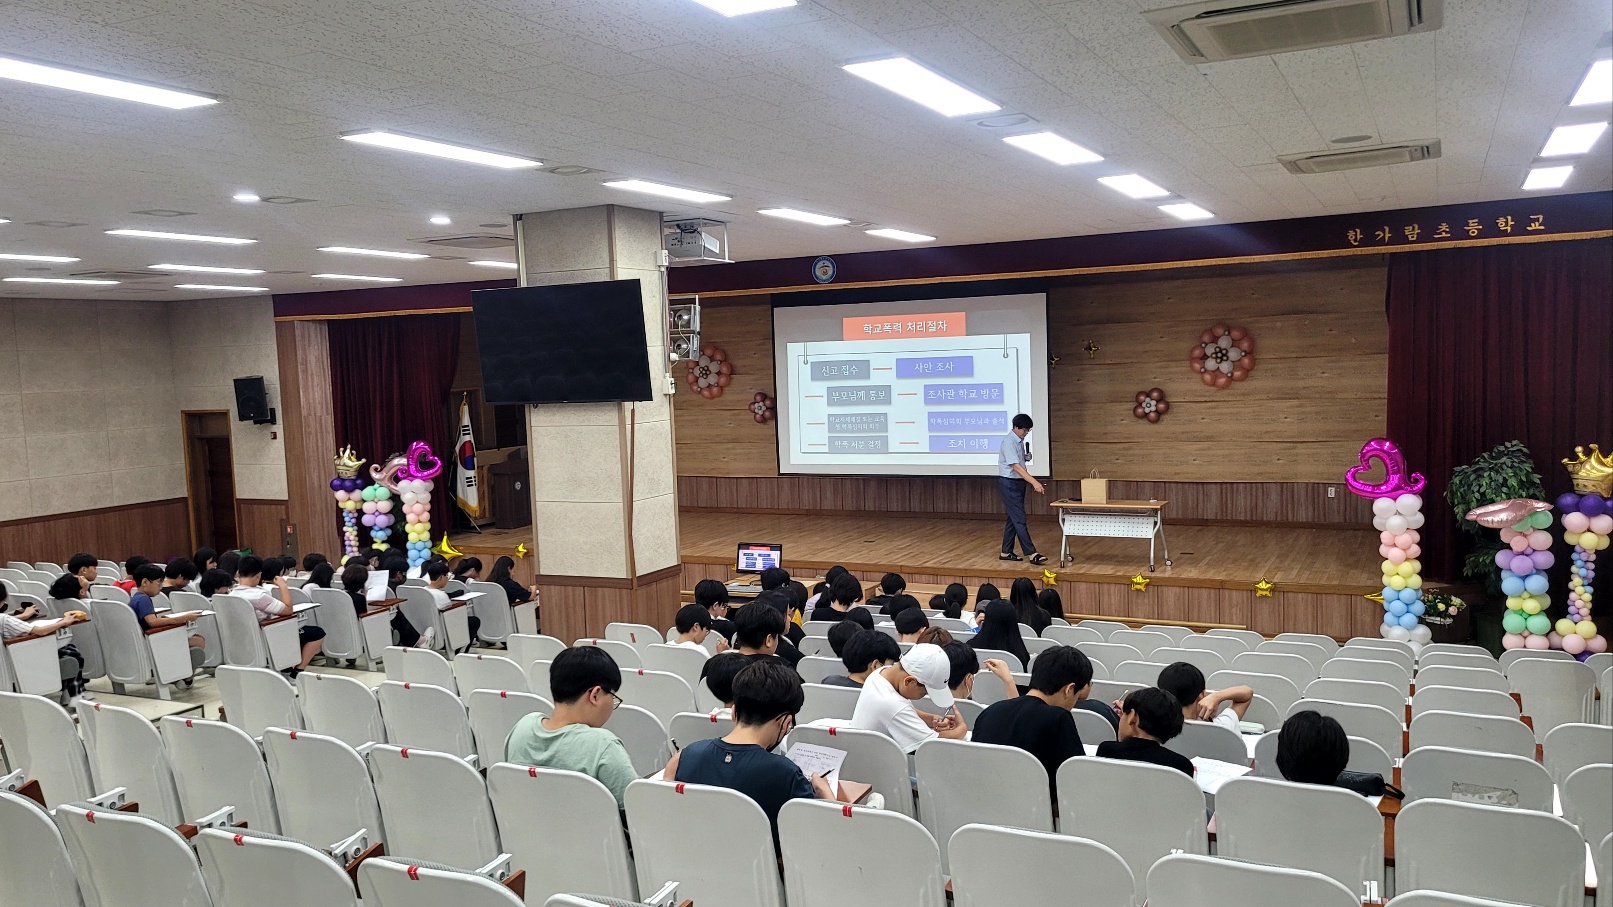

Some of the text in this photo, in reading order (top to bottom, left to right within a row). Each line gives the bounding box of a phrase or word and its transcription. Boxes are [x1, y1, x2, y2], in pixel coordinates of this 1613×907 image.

[1347, 214, 1545, 246] 한가람초등학교
[863, 320, 948, 335] 학교폭력 처리절차
[821, 364, 859, 377] 신고 접수
[914, 361, 954, 374] 사안 조사
[831, 390, 887, 402] 부모님께 통보
[927, 388, 1000, 400] 조사관 학교 방문
[834, 440, 881, 450] 학폭 처분 결정
[947, 438, 989, 450] 조치 이행
